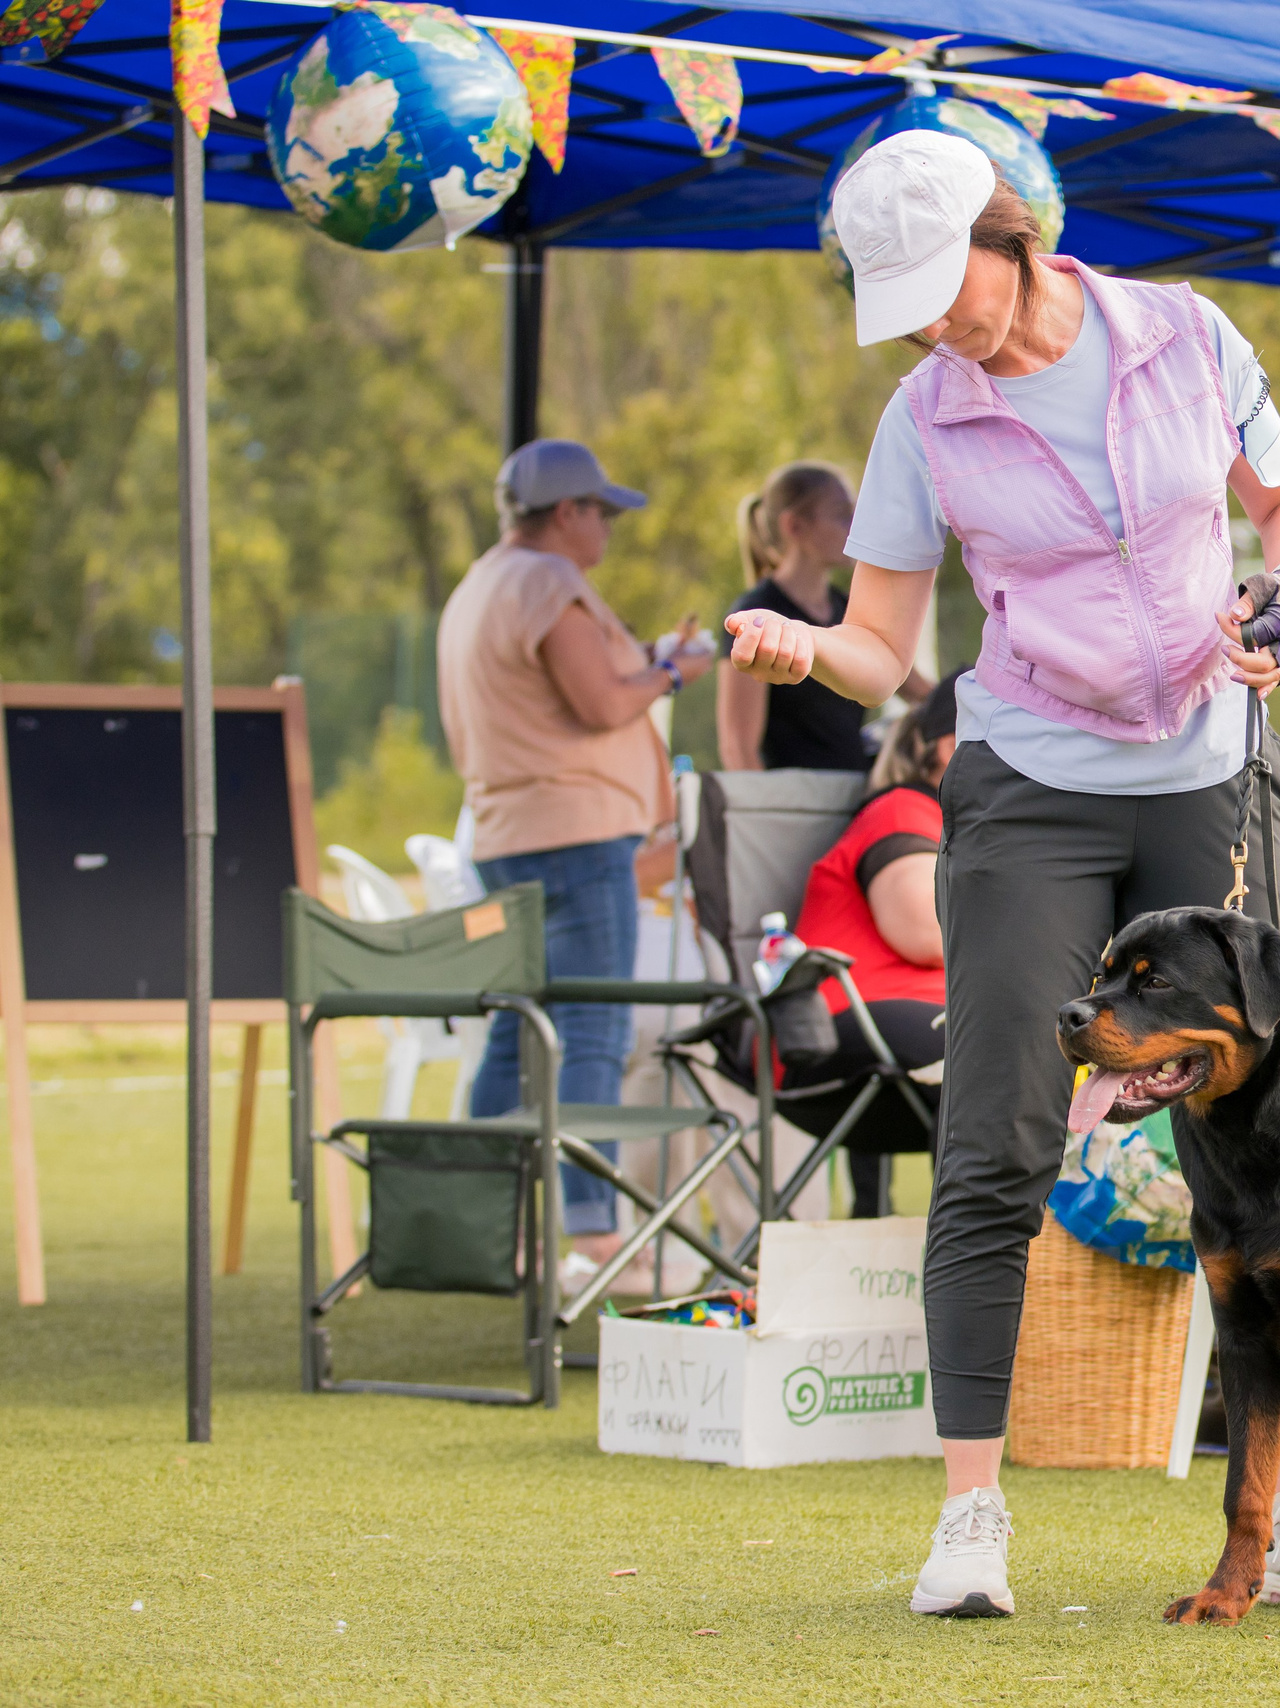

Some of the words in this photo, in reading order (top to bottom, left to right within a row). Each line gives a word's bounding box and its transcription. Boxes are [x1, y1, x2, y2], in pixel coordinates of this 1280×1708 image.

[806, 1334, 929, 1375] ФЛАГ
[602, 1353, 727, 1420] ФЛАГИ
[830, 1374, 915, 1397] NATURE'S
[829, 1393, 914, 1412] PROTECTION
